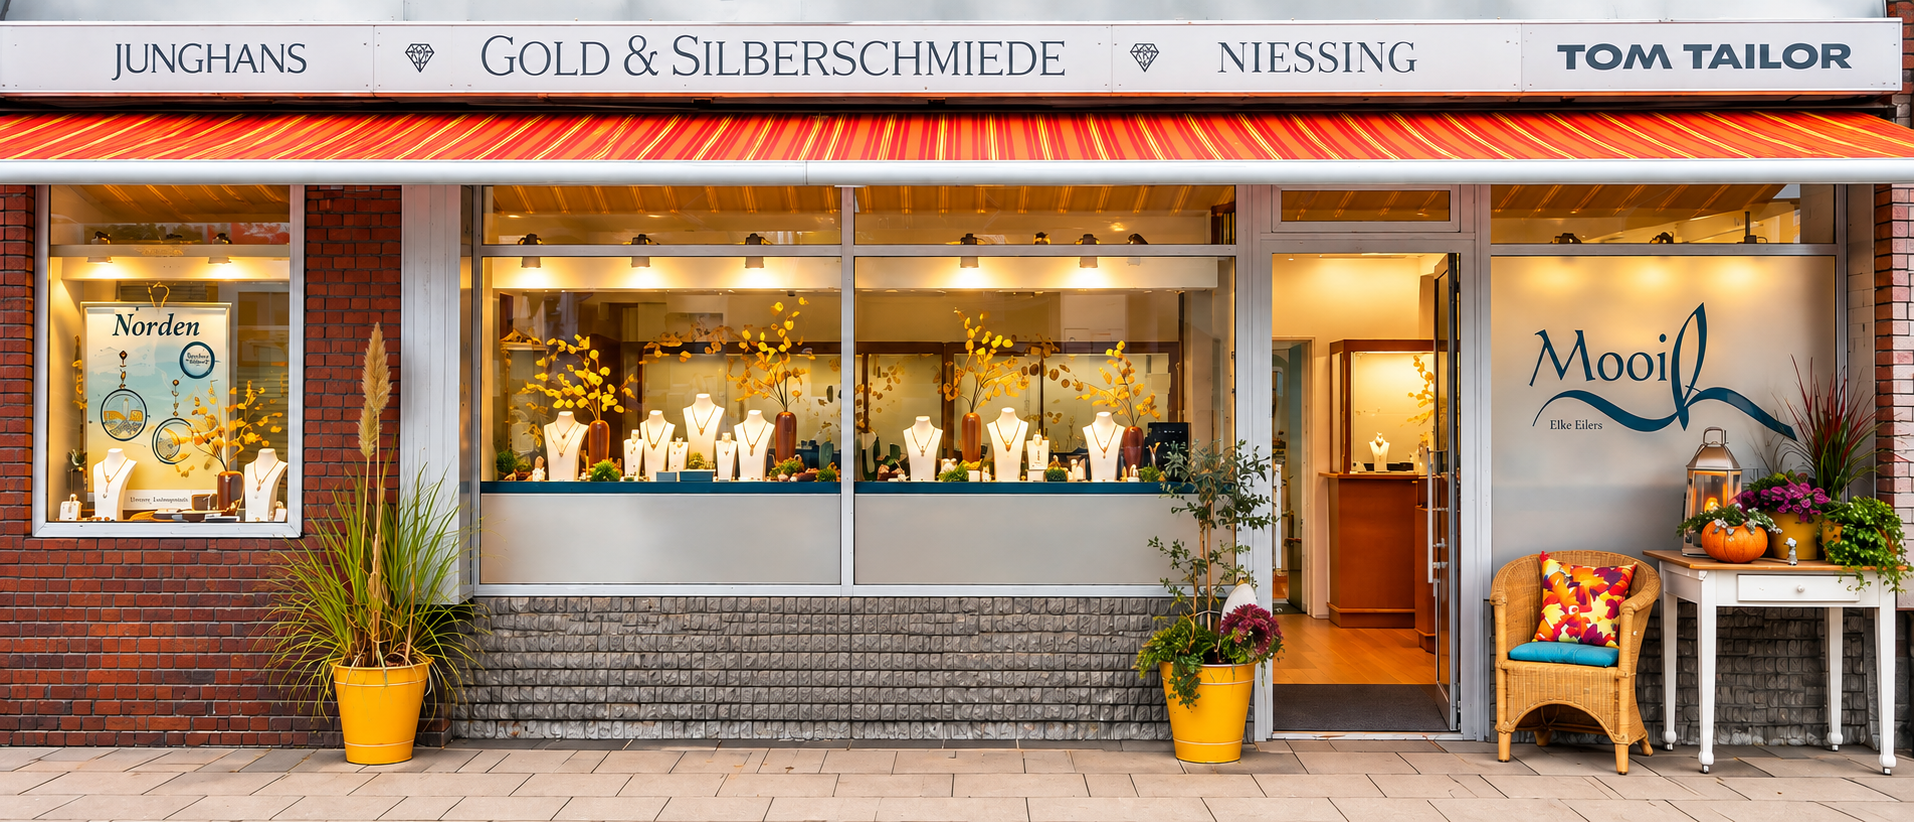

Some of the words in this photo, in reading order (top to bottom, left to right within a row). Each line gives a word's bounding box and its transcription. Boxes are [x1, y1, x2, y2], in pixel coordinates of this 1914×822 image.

[112, 43, 307, 80] JUNGHANS
[481, 35, 610, 76] GOLD
[623, 34, 659, 76] &
[672, 34, 1066, 76] SILBERSCHMIEDE
[1218, 41, 1417, 73] NIESSING
[1556, 43, 1673, 70] TOM
[1683, 43, 1852, 70] TAILOR
[112, 312, 200, 337] Norden
[1550, 419, 1572, 430] Elke
[1575, 419, 1603, 430] Eilers
